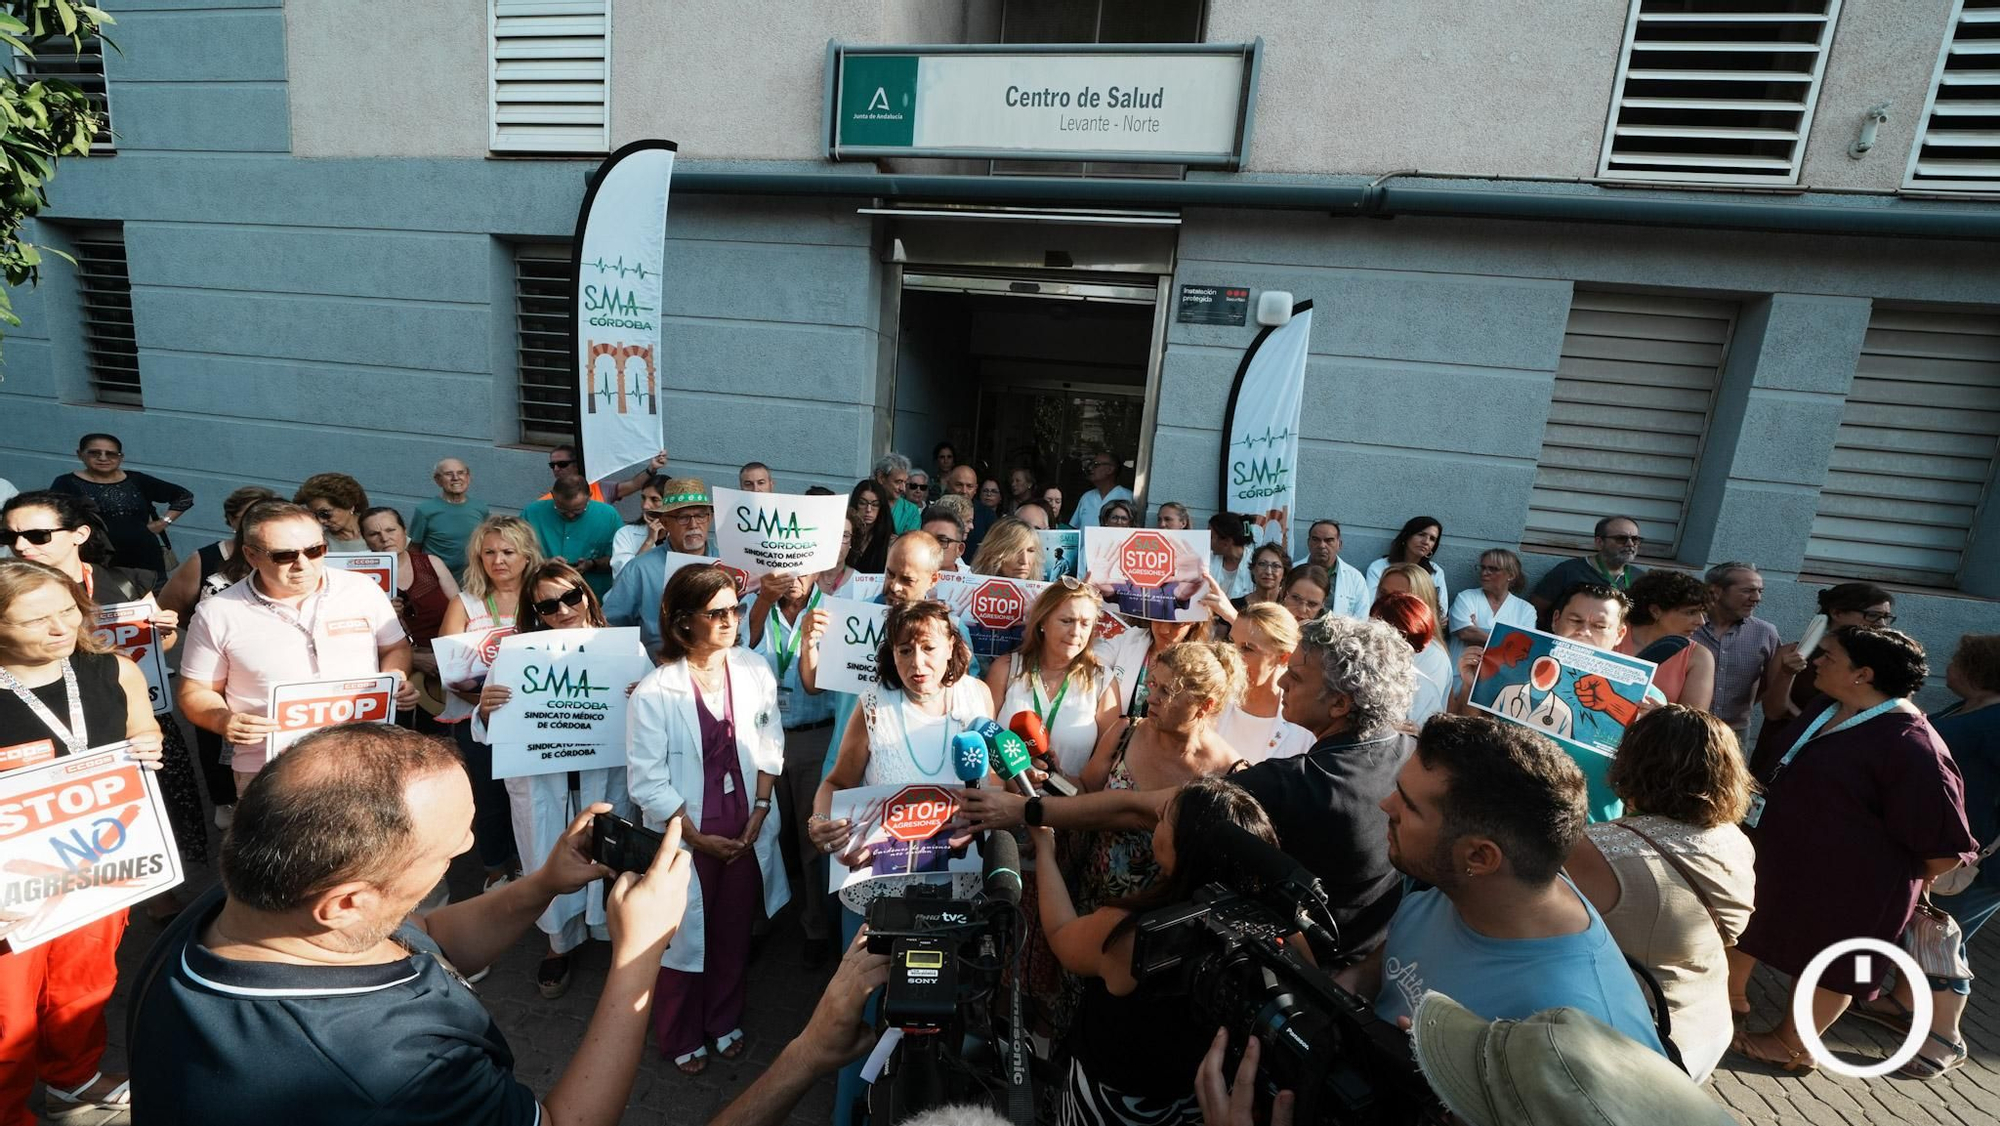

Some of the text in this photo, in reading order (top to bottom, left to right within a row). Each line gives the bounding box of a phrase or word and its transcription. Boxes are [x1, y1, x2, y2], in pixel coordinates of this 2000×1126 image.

[1005, 85, 1164, 109] Centro de Salud
[876, 112, 903, 120] Andalucía
[1059, 114, 1110, 132] Levante
[1123, 114, 1160, 133] Norte
[585, 284, 648, 316] SMA
[590, 313, 652, 331] CÓRDOBA
[737, 506, 808, 539] SMA
[1135, 537, 1159, 551] SAS
[744, 547, 815, 560] SINDICATO MÉDICO
[1126, 551, 1168, 569] STOP
[756, 558, 804, 568] DE CÓRDOBA
[1128, 568, 1166, 577] AGRESIONES
[988, 585, 1011, 598] SAS
[977, 596, 1018, 614] STOP
[979, 613, 1015, 621] AGRESIONES
[847, 662, 877, 673] SINDICA
[522, 664, 598, 698] SMA
[285, 698, 377, 727] STOP
[525, 710, 604, 721] SINDICATO MÉDICO
[537, 719, 591, 730] DE CÓRDOBA
[983, 720, 1000, 738] tve
[541, 747, 596, 760] DE CÓRDOBA
[0, 775, 126, 836] STOP
[891, 801, 946, 822] STOP
[893, 818, 941, 829] AGRESIONES
[49, 817, 126, 872] NO
[4, 853, 164, 907] AGRESIONES
